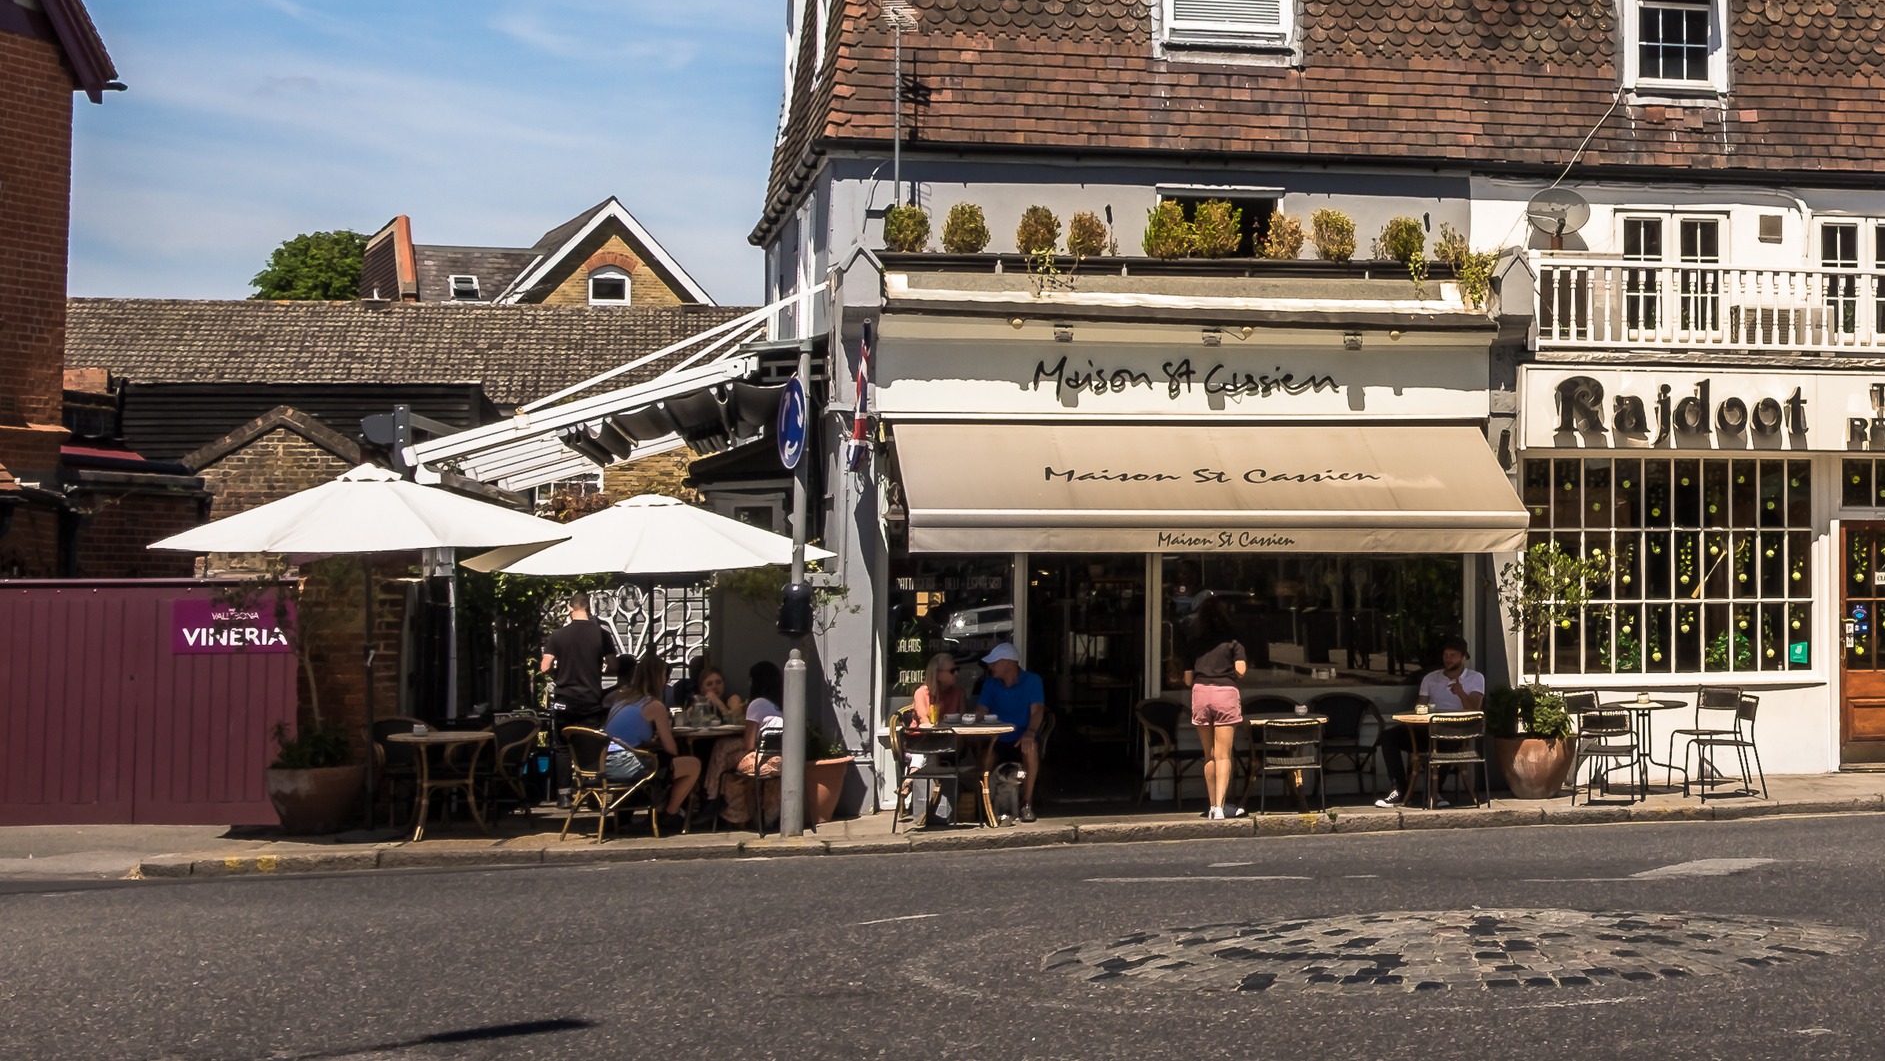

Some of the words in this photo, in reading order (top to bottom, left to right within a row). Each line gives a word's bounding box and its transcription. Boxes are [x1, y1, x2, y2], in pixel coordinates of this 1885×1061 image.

[1034, 356, 1154, 401] Maison
[1204, 364, 1340, 397] Cassien
[1555, 376, 1808, 447] Rajdoot
[1044, 466, 1182, 483] Maison
[1192, 468, 1232, 484] St
[1243, 468, 1382, 484] Cassien
[1157, 531, 1213, 548] Maison
[1217, 531, 1235, 548] St
[1238, 531, 1296, 548] Cassien
[182, 627, 288, 647] VINERIA
